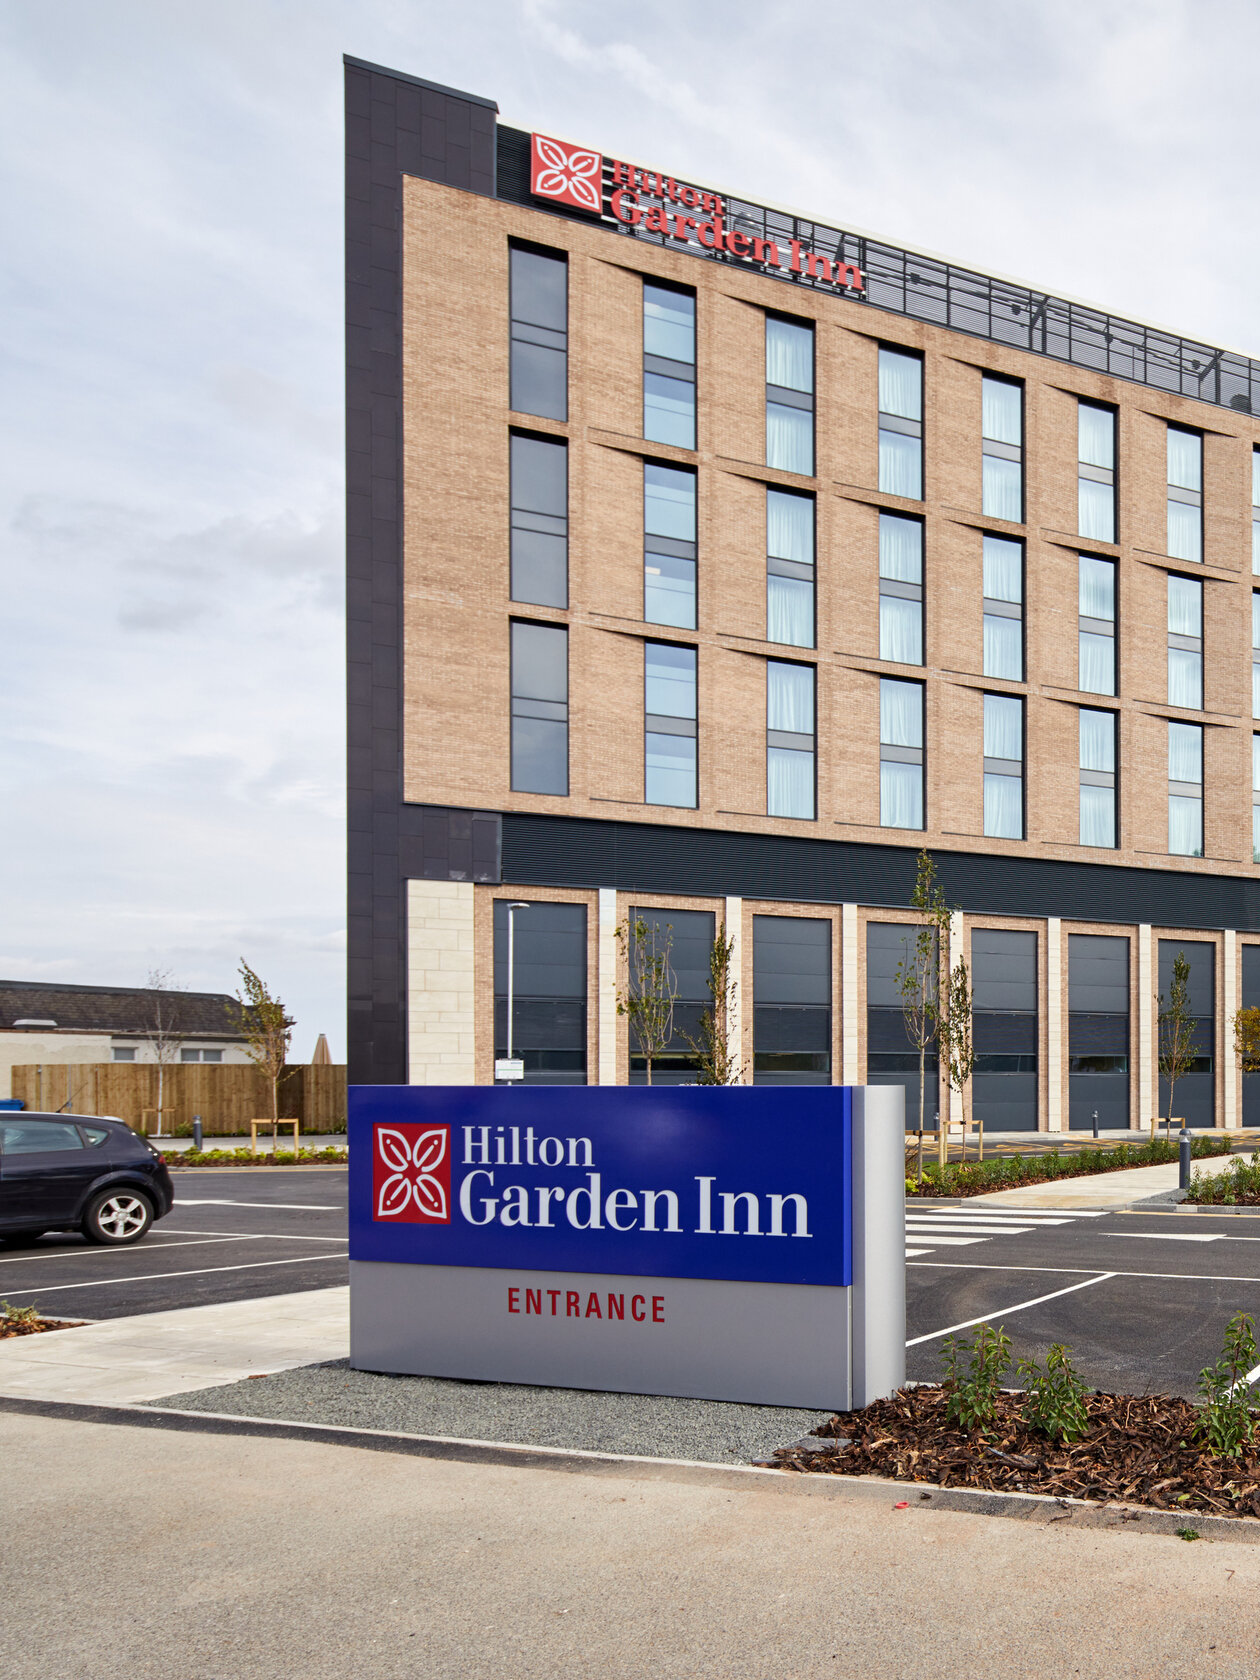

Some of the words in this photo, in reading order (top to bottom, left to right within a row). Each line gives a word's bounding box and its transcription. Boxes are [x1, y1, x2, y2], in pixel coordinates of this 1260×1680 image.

[610, 158, 726, 217] Hilton
[610, 188, 782, 268] Garden
[788, 238, 866, 292] Inn
[461, 1125, 596, 1168] Hilton
[458, 1169, 684, 1234] Garden
[694, 1175, 814, 1239] Inn
[507, 1286, 667, 1324] ENTRANCE
